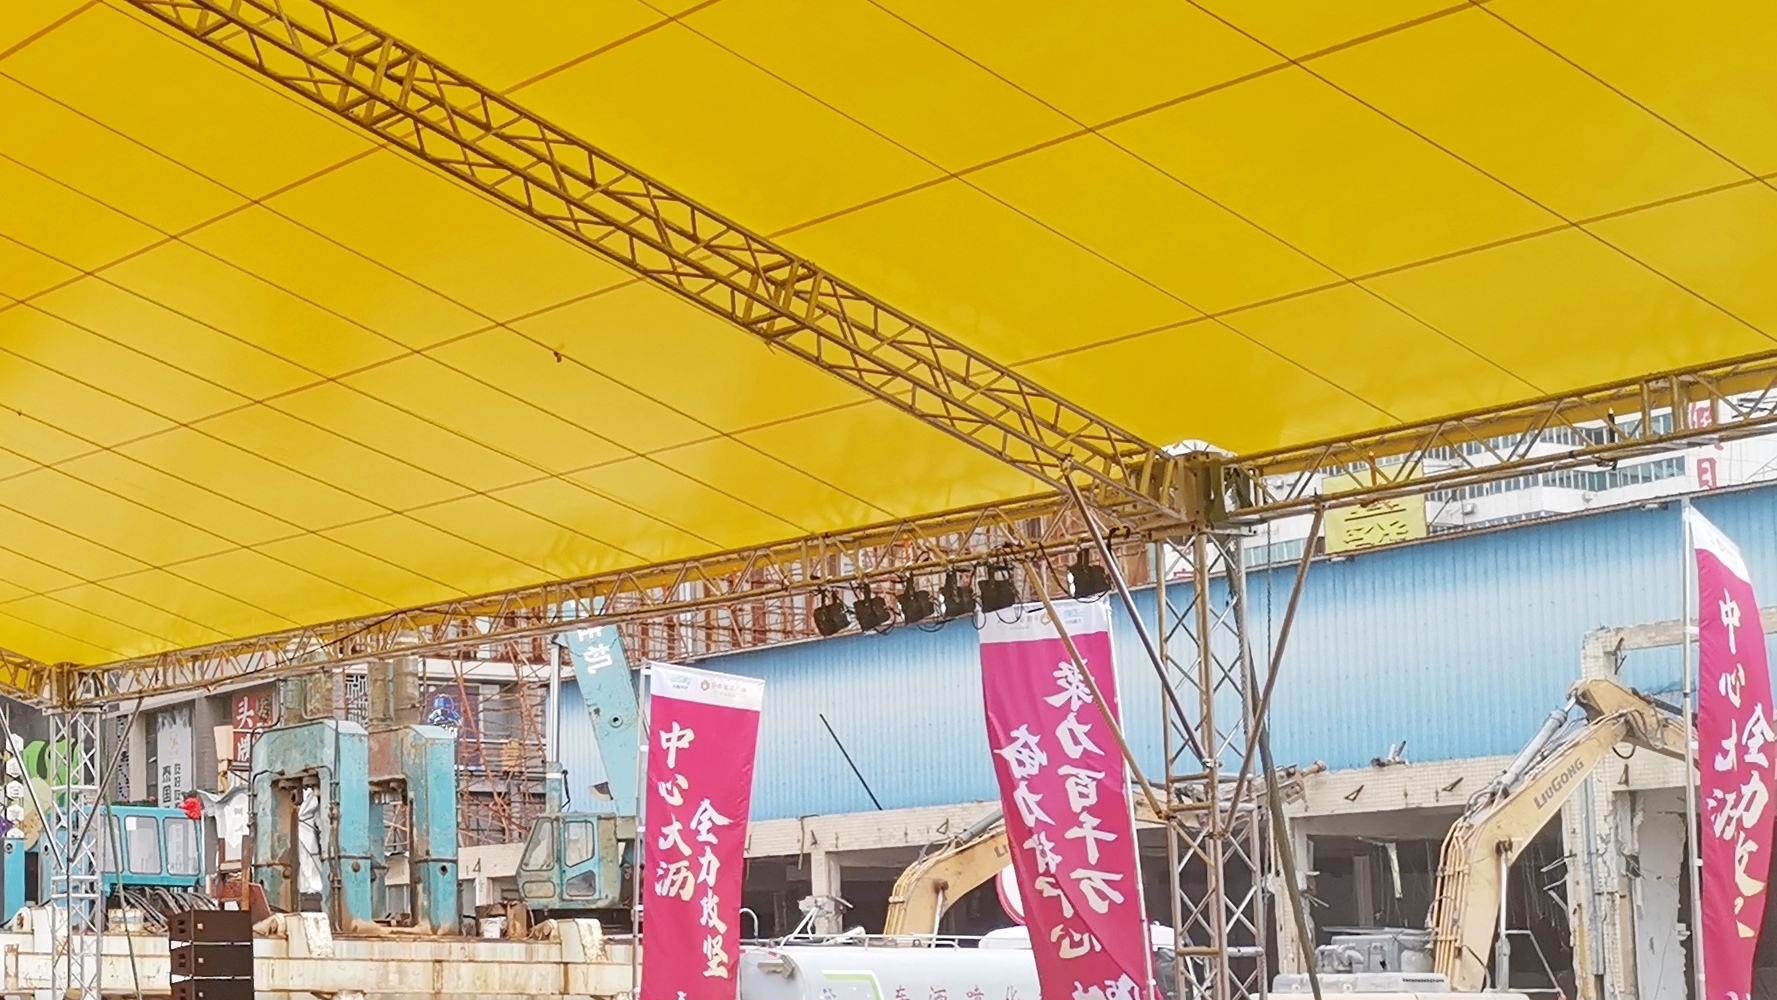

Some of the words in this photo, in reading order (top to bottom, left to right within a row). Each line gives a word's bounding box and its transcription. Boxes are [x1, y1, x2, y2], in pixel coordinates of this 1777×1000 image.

[655, 722, 695, 901] 中心大沥
[1533, 757, 1584, 810] LIUGONG
